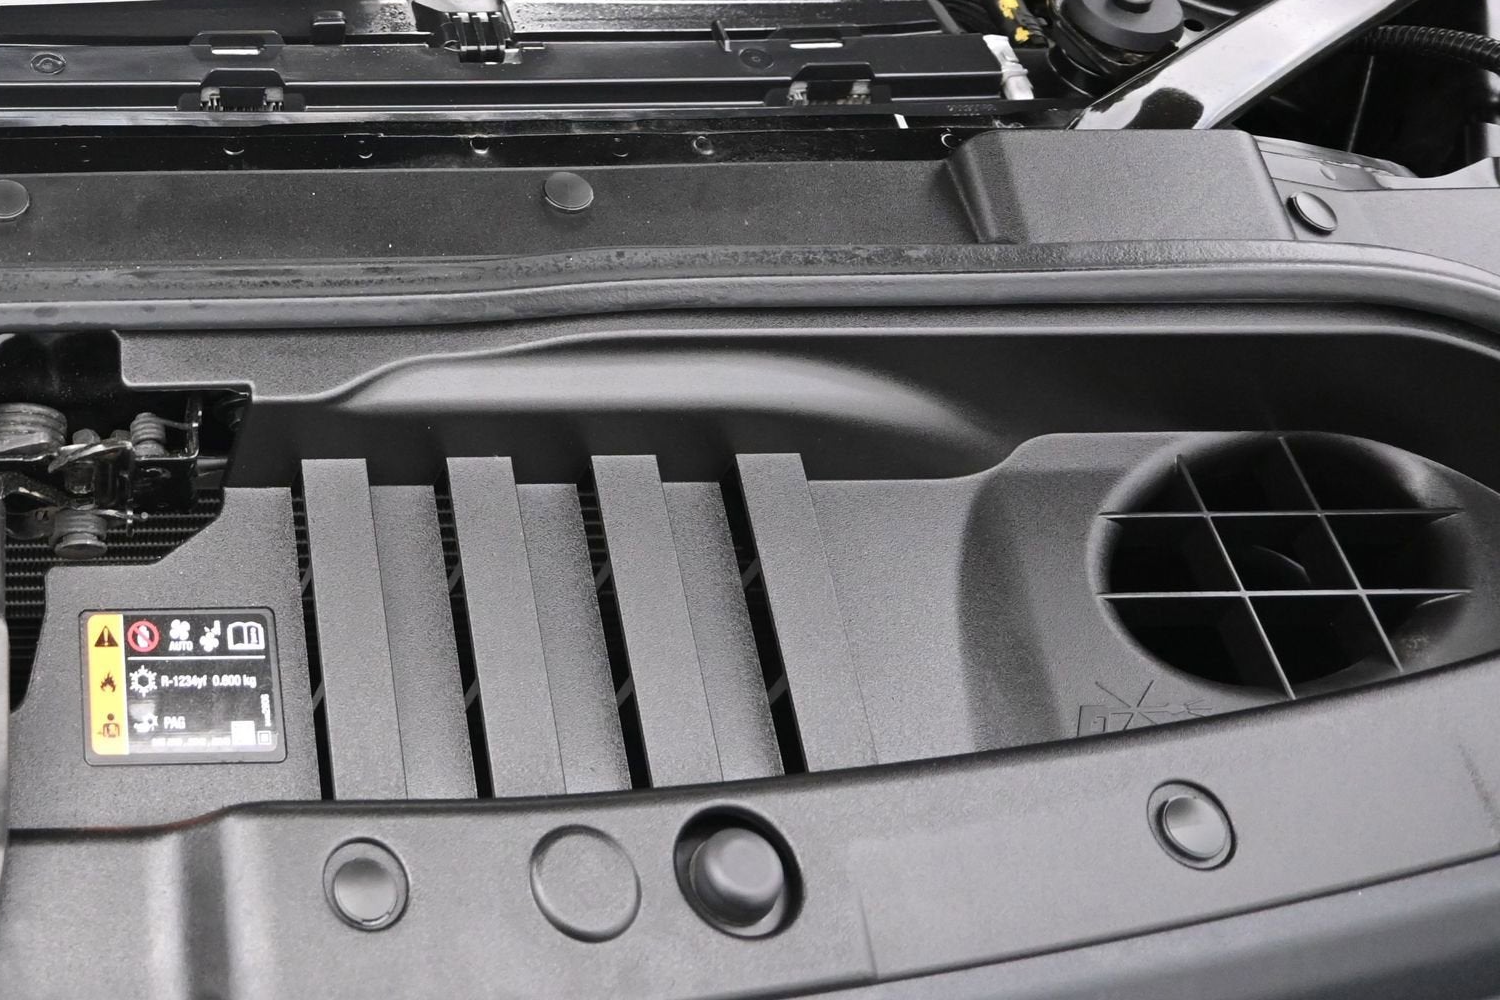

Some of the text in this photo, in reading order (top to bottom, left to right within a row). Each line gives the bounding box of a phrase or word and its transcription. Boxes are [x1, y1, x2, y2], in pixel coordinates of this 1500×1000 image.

[168, 640, 194, 651] AUTO
[160, 674, 207, 689] R-1234yf
[242, 674, 257, 688] kg
[163, 716, 186, 729] PAG
